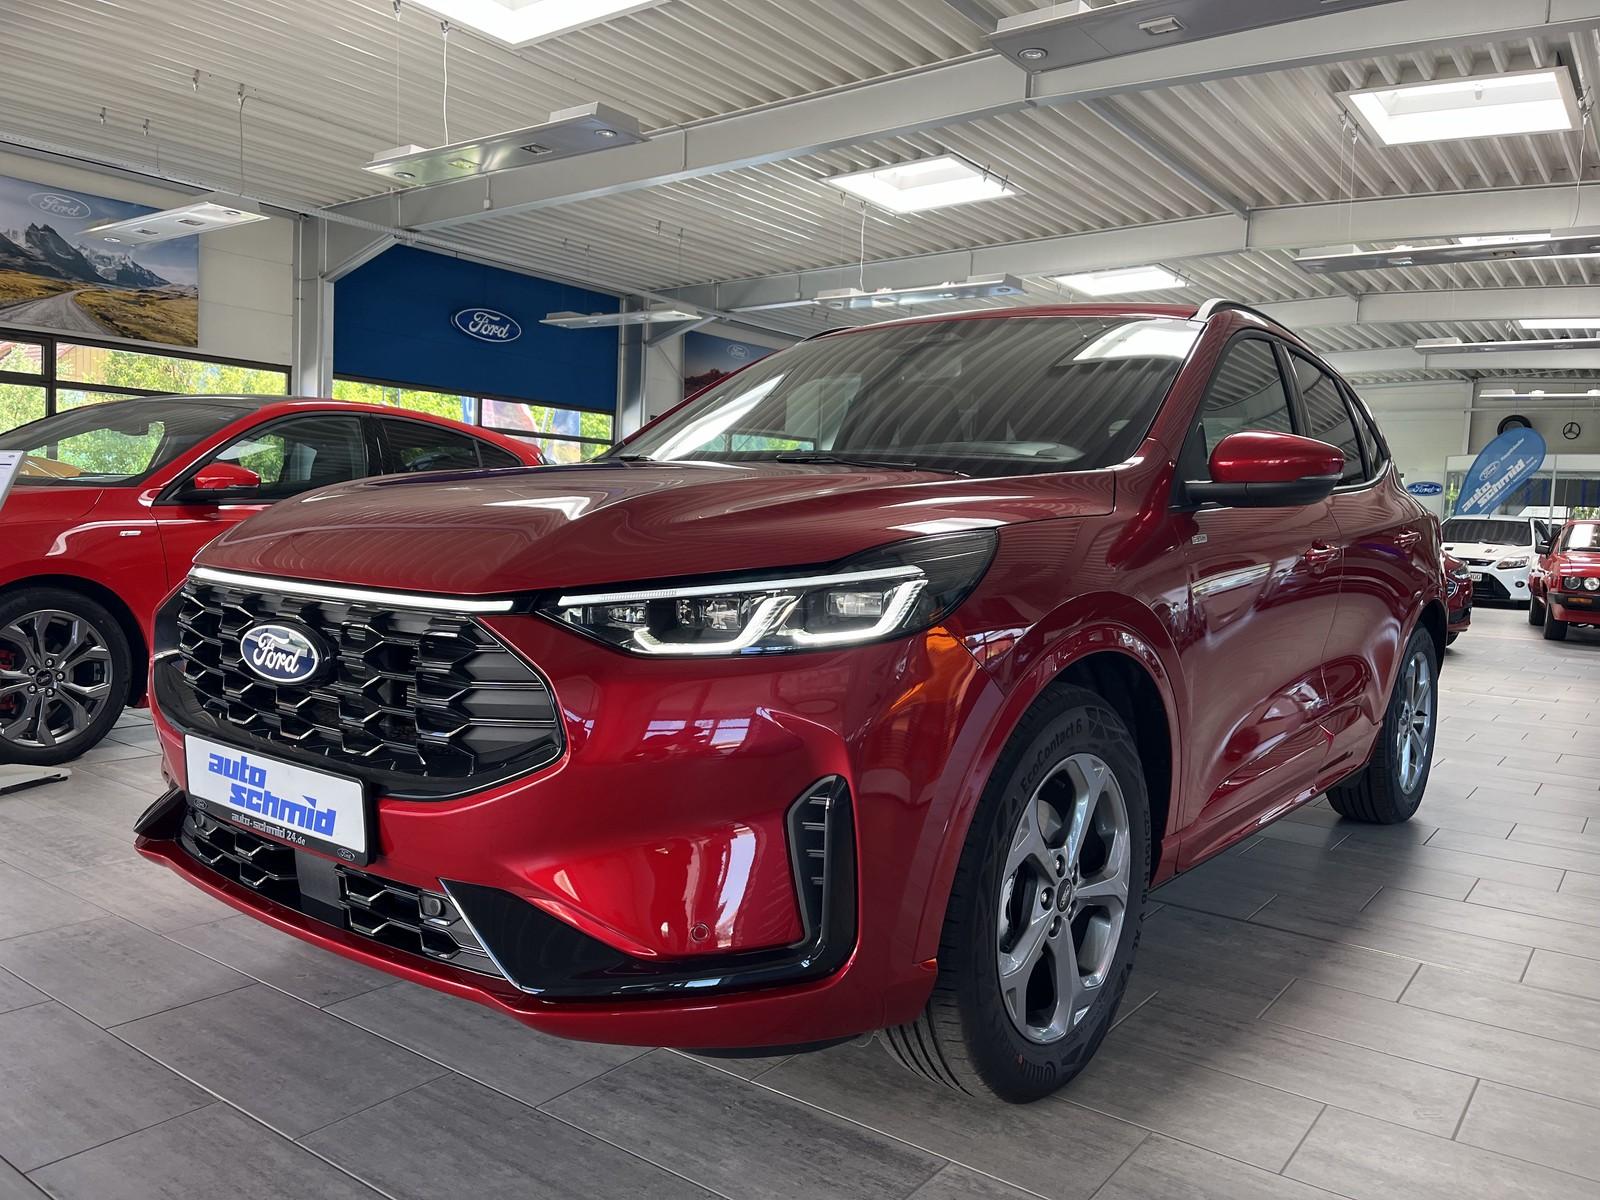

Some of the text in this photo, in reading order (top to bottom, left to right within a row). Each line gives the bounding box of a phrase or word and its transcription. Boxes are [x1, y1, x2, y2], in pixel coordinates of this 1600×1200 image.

[39, 195, 80, 217] Ford
[468, 311, 510, 339] Ford
[1461, 481, 1492, 513] auto
[1477, 458, 1526, 508] schmid
[253, 632, 300, 674] Ford
[208, 752, 267, 789] auto
[1020, 718, 1083, 794] EcoContact 6
[229, 783, 337, 837] schmid
